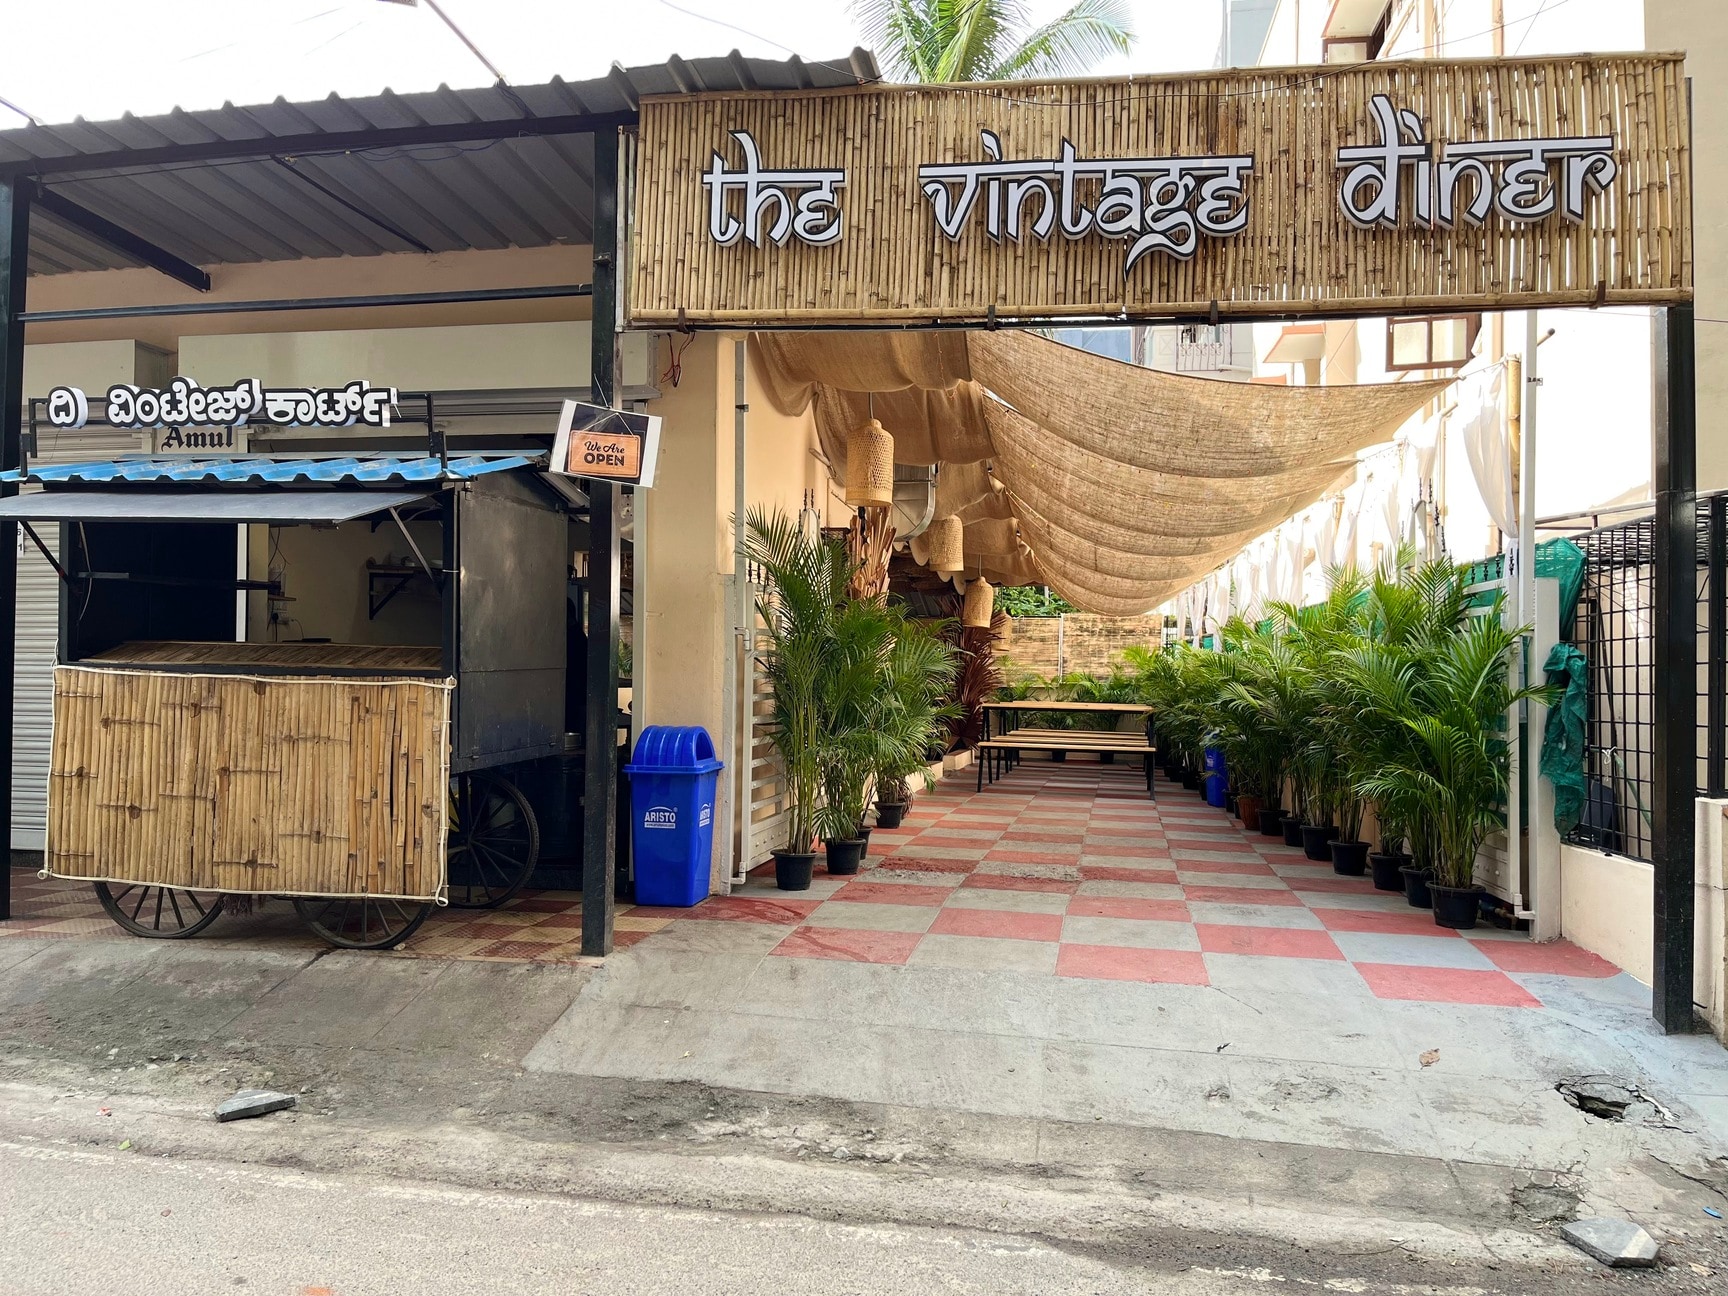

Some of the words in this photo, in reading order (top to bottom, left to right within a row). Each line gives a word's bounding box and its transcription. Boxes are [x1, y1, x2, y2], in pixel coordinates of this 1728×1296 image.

[702, 130, 845, 248] the
[918, 129, 1254, 282] vintage
[1336, 93, 1617, 230] diner
[47, 385, 88, 428] ದಿ
[105, 376, 261, 428] ವಿಂಟೇಜ್
[161, 425, 233, 452] Amul
[584, 440, 602, 452] We
[603, 443, 625, 453] Are
[584, 452, 625, 467] OPEN
[644, 811, 676, 822] ARISTO
